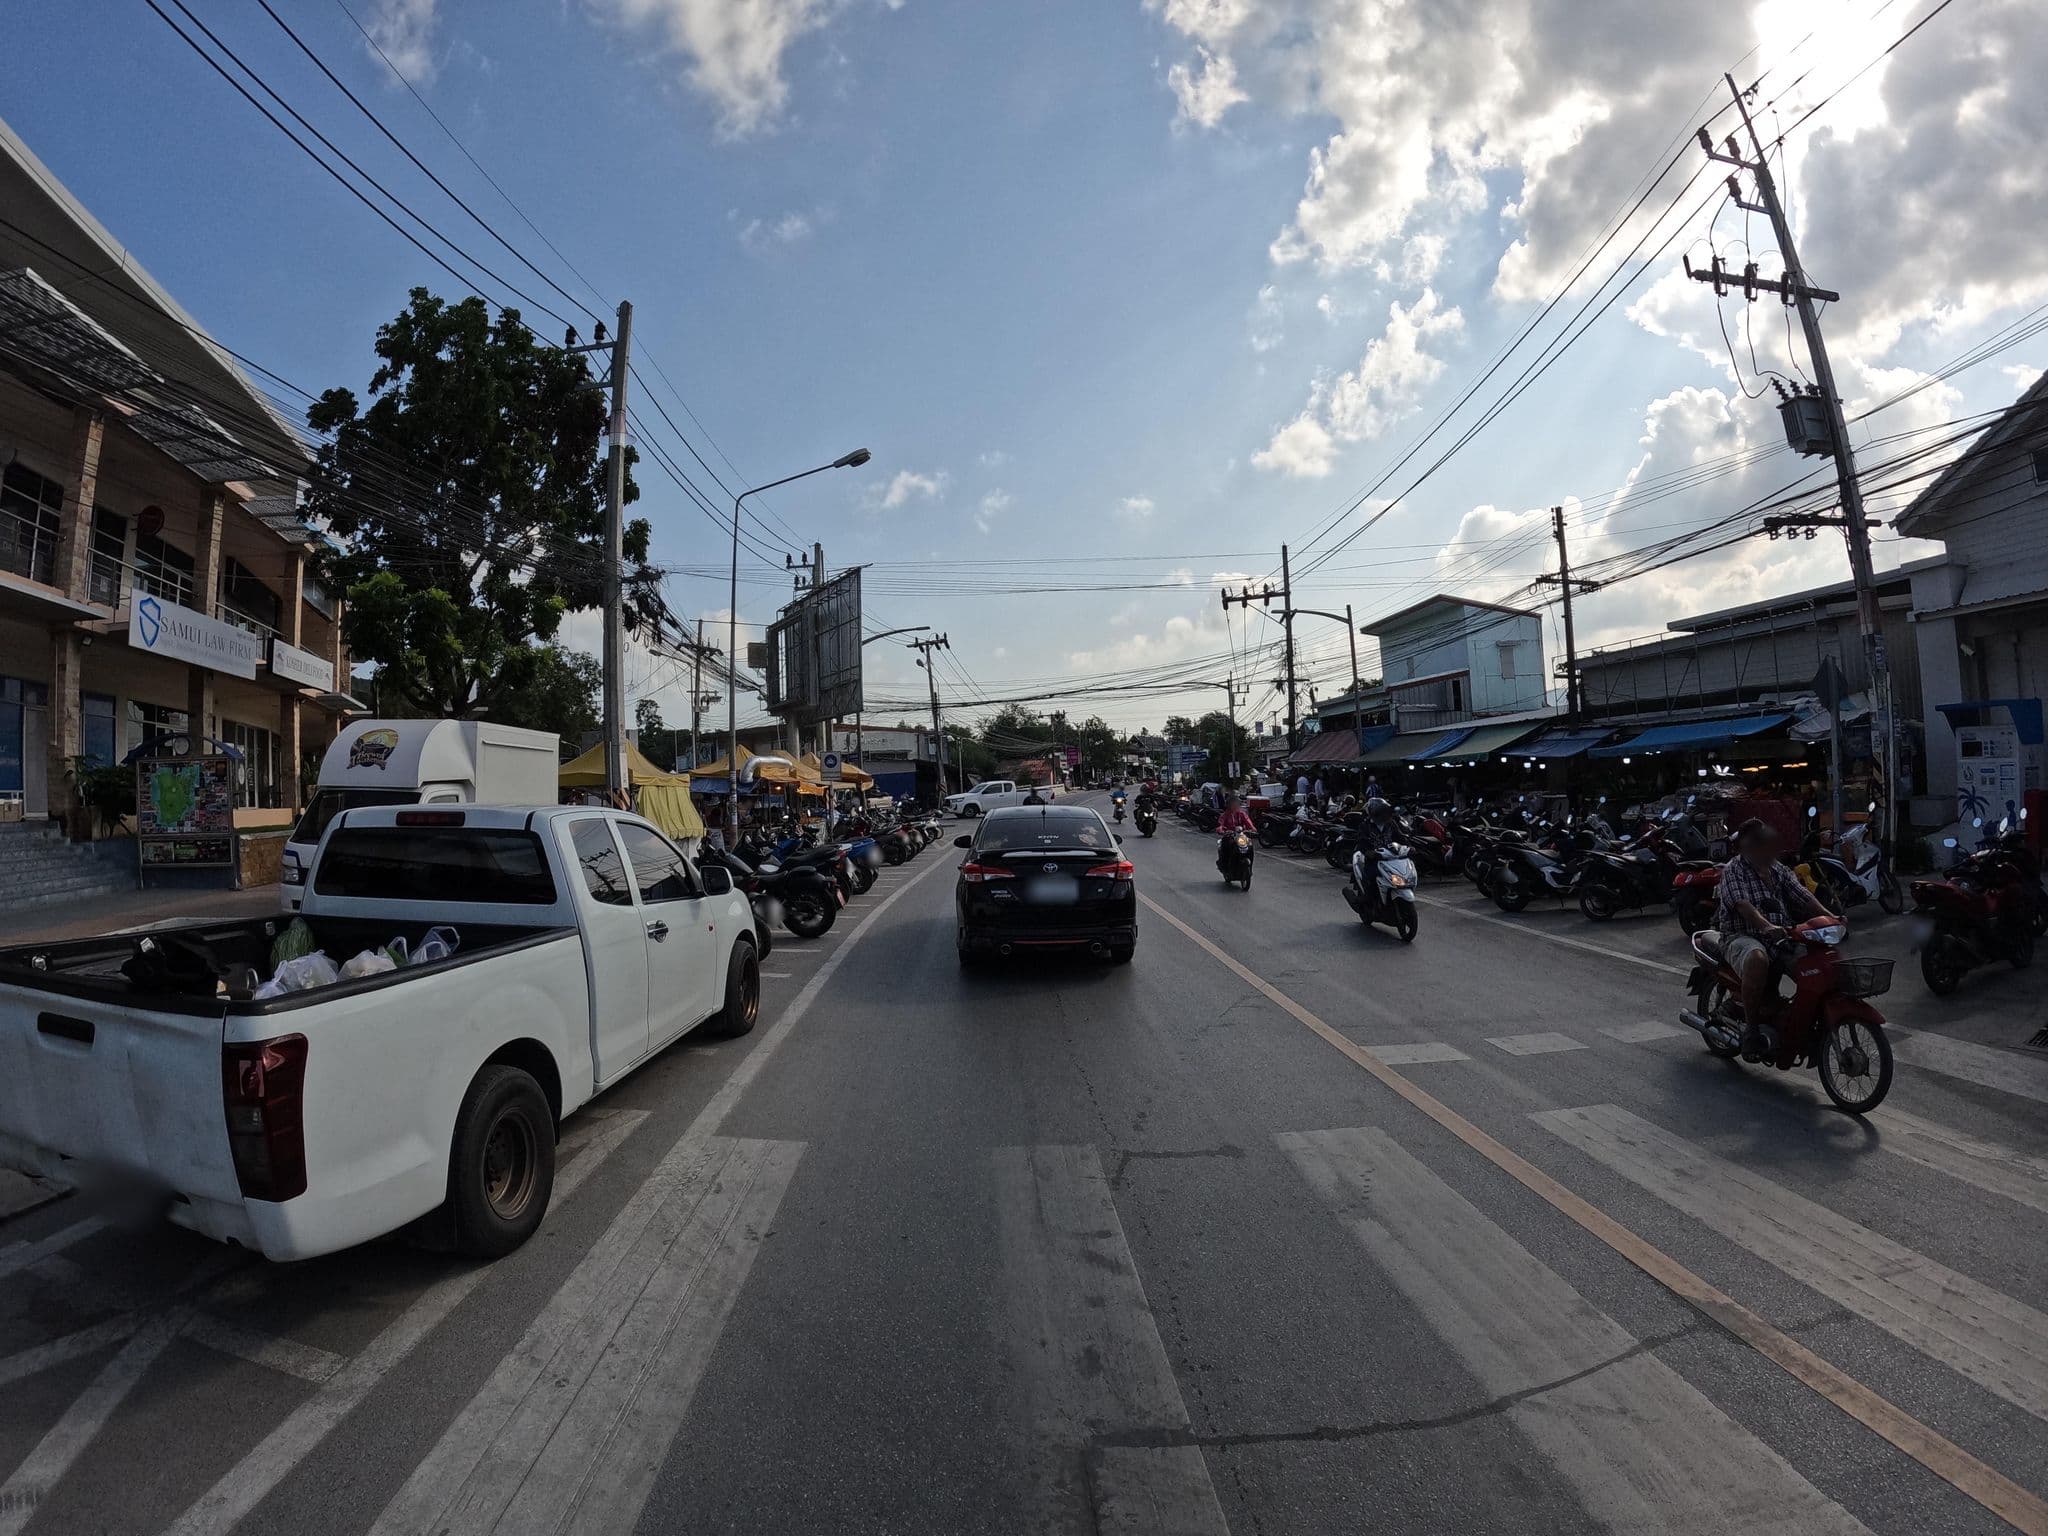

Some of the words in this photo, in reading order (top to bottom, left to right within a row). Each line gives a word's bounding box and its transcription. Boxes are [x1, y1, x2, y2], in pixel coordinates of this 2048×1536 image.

[160, 616, 201, 644] SAMUI
[205, 631, 226, 653] LAW
[229, 639, 252, 661] FIRM
